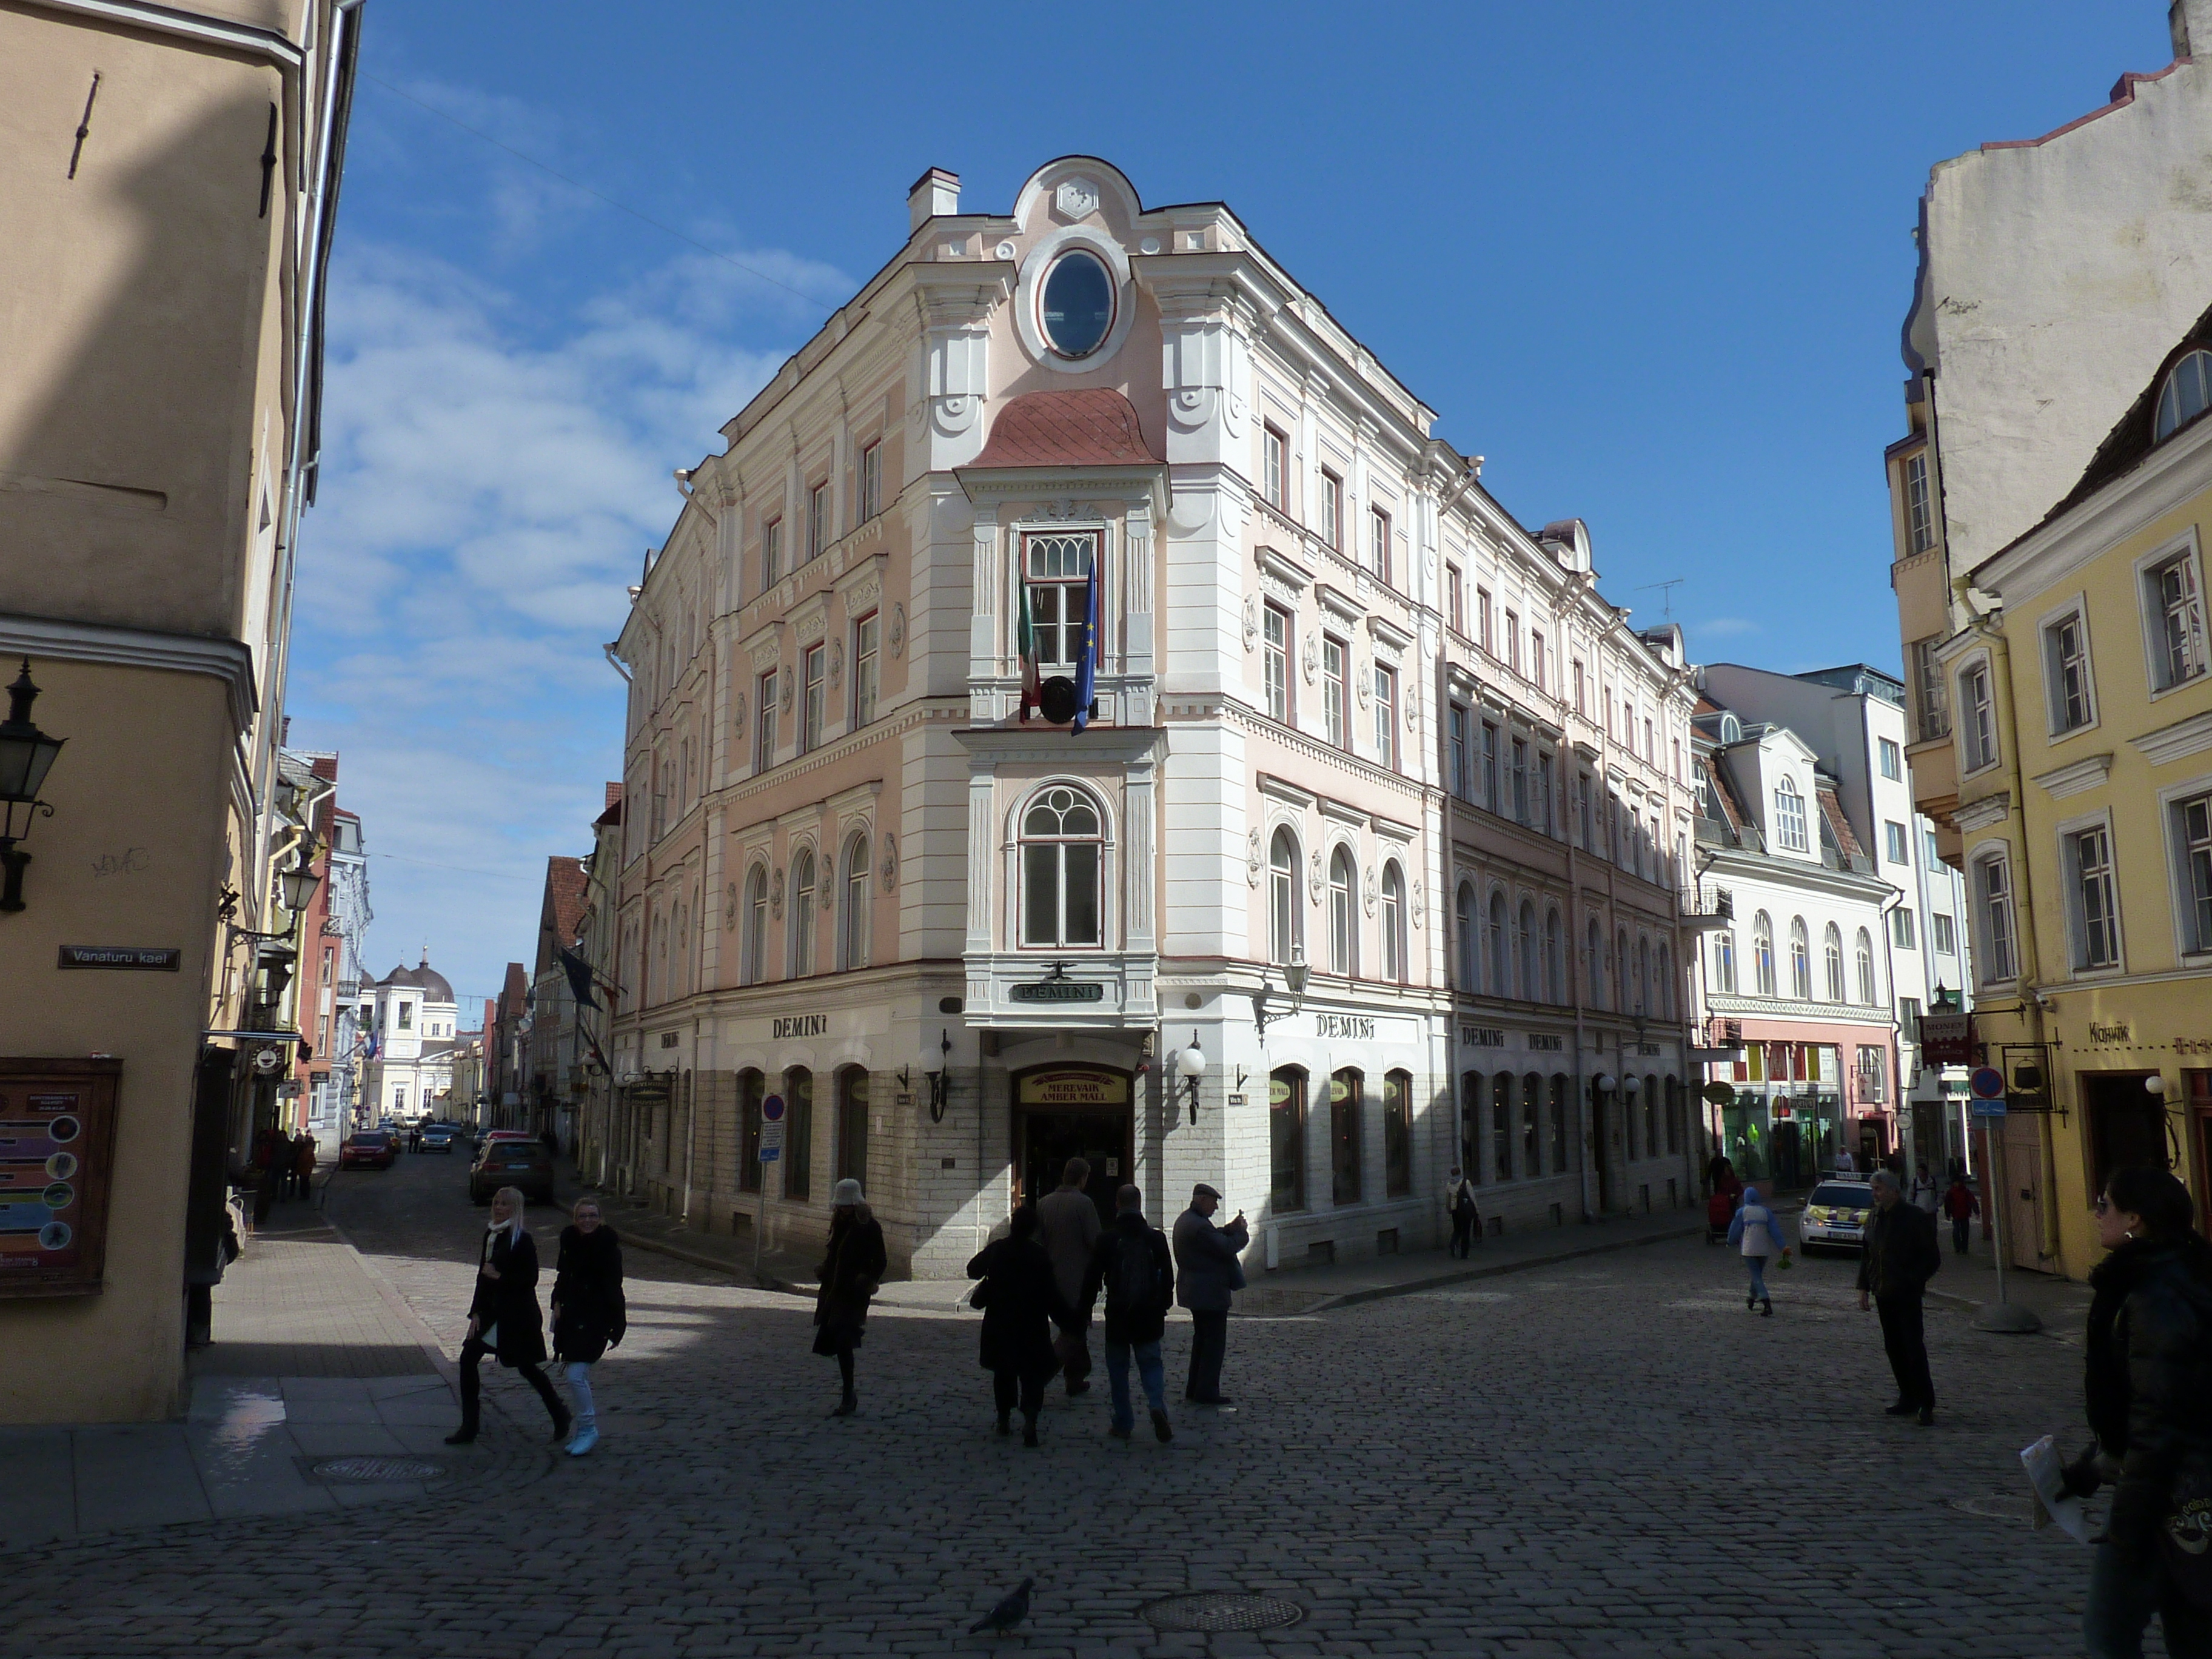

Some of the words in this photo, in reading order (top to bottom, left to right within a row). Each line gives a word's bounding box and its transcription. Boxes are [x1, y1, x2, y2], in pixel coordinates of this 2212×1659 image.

[73, 950, 133, 963] Vanaturu
[139, 953, 167, 964] kael
[1048, 1084, 1099, 1092] MEREVAIK
[1041, 1093, 1077, 1101] AMBER
[1079, 1093, 1107, 1101] MALL
